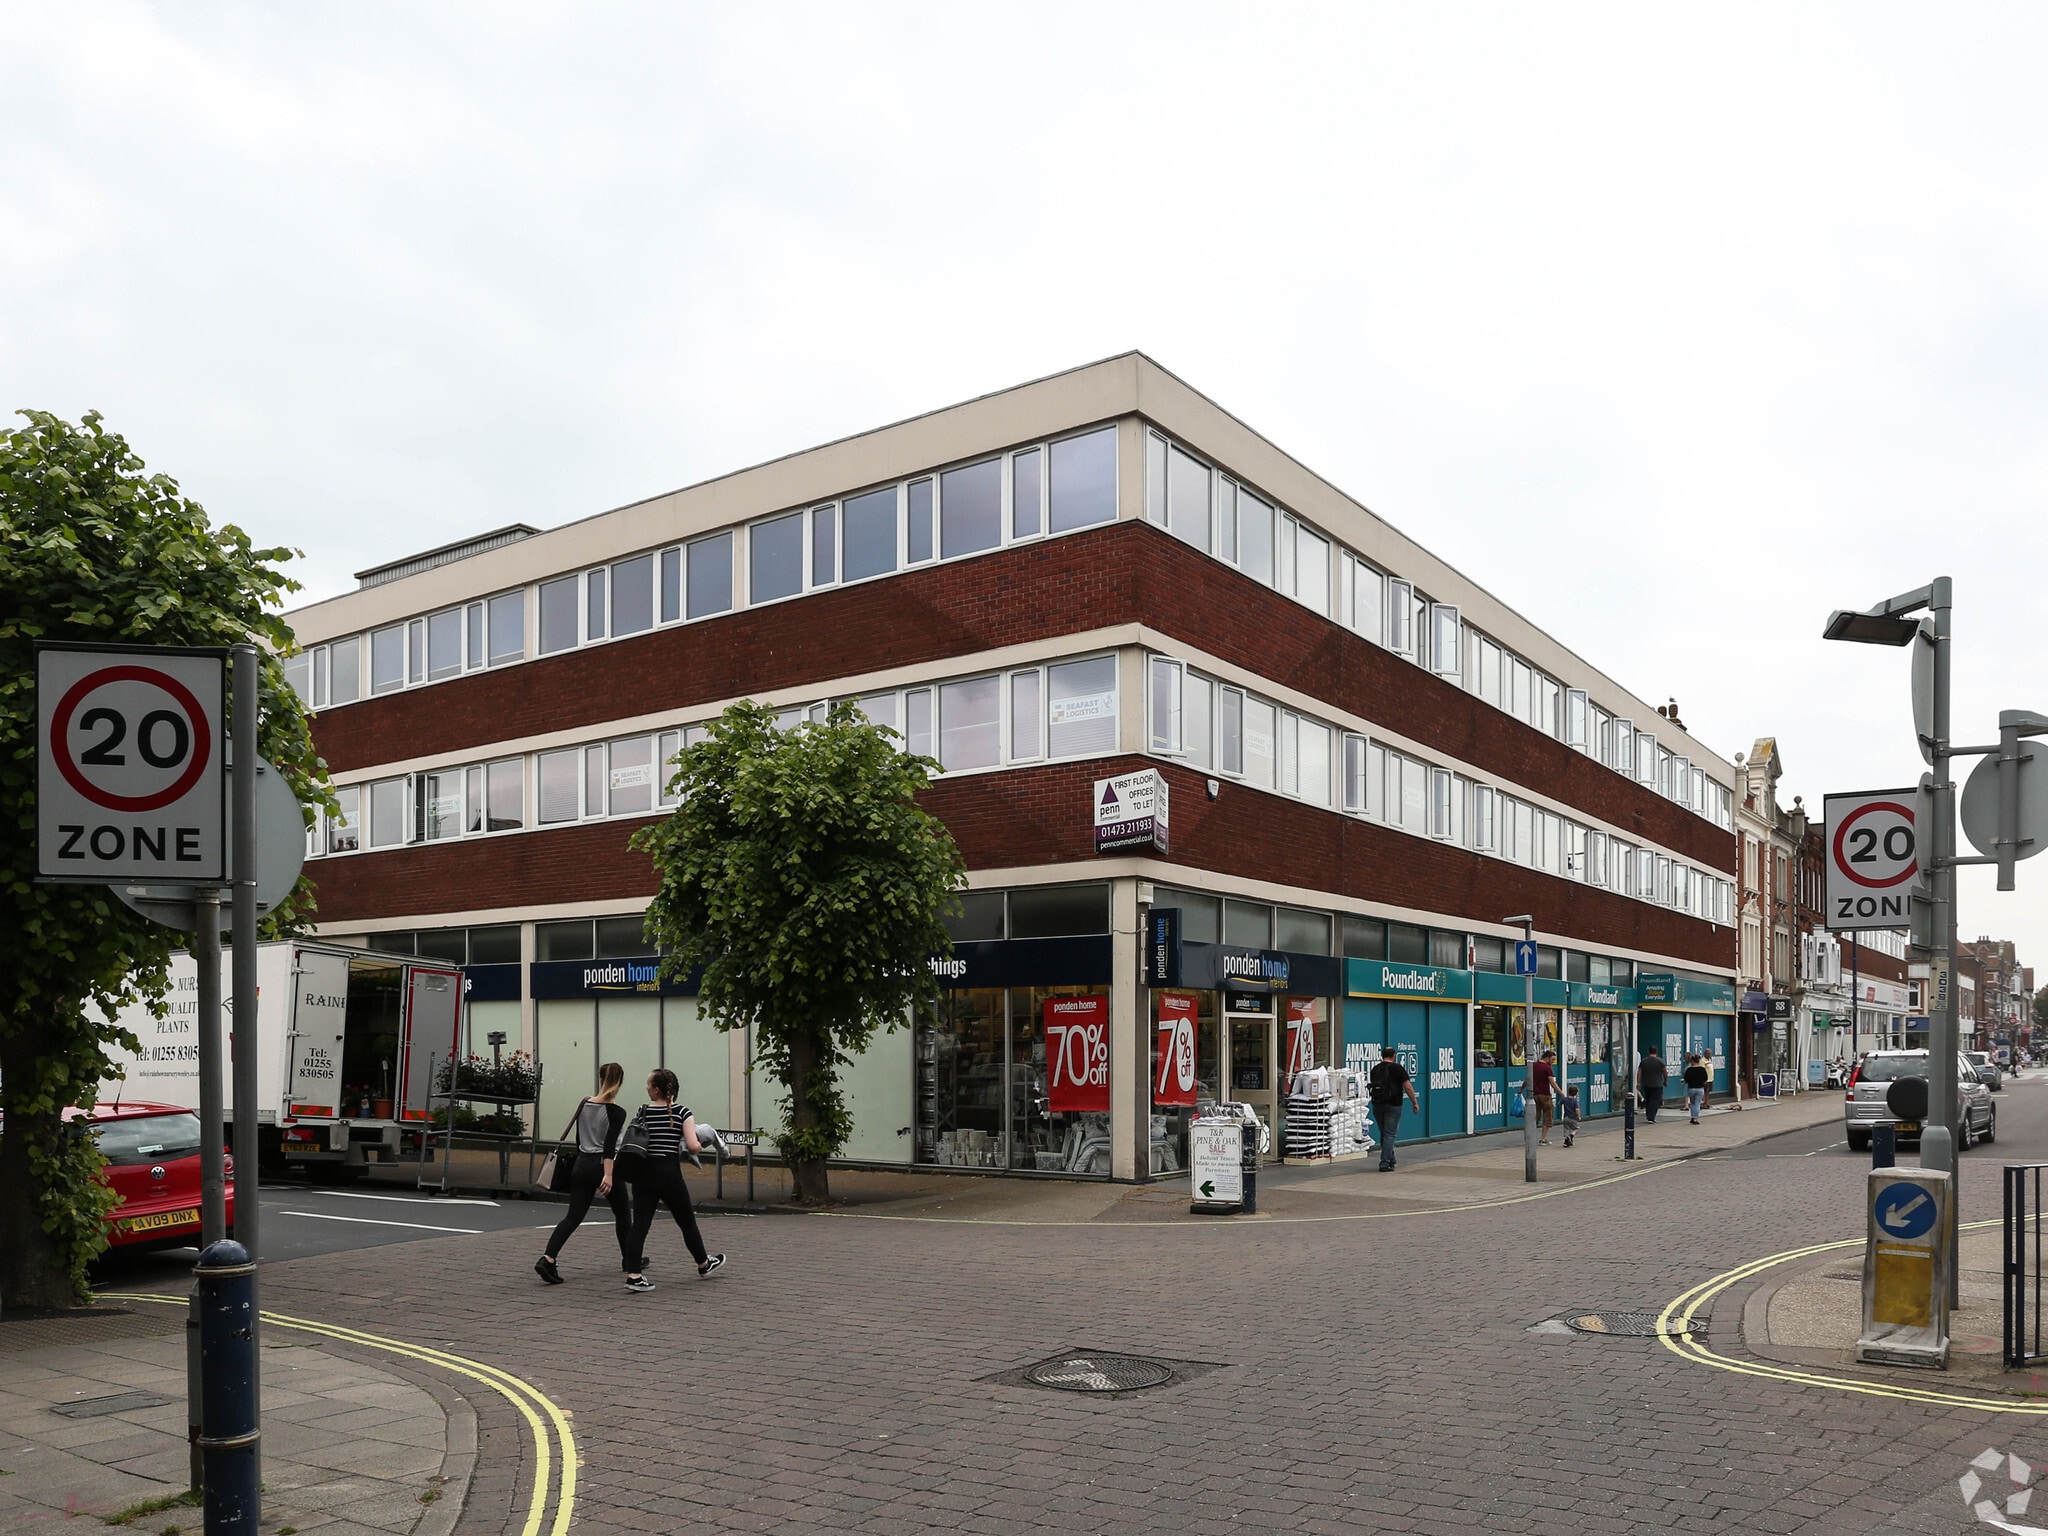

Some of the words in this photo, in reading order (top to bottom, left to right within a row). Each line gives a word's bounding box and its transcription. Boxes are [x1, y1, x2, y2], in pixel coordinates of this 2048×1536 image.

[1066, 700, 1098, 710] SEAFAST
[1066, 708, 1099, 718] LOGISTICS
[78, 707, 190, 769] 20
[1115, 779, 1131, 790] FIRST
[1132, 774, 1154, 786] FLOOR
[1128, 787, 1154, 799] OFFICES
[1100, 804, 1120, 818] penn
[1133, 802, 1142, 811] TO
[1143, 799, 1154, 809] LET
[1101, 824, 1125, 838] 01473
[1126, 818, 1152, 834] 211933
[57, 824, 202, 862] ZONE
[1100, 833, 1154, 850] penncommercial.co.uk
[1849, 825, 1915, 863] 20
[1837, 895, 1911, 918] ZON
[1156, 918, 1165, 944] home
[1155, 945, 1167, 979] ponden
[1223, 952, 1260, 979] ponden
[1262, 954, 1288, 978] home
[584, 963, 625, 988] ponden
[1382, 966, 1435, 991] Poundland
[177, 977, 198, 991] NUR
[1588, 987, 1618, 1004] Poundland
[166, 1001, 198, 1017] QUALIT
[1053, 1001, 1078, 1013] ponden
[1078, 1000, 1097, 1010] home
[156, 1020, 190, 1034] PLANTS
[152, 1045, 176, 1061] 01255
[177, 1045, 199, 1061] 8305
[308, 1047, 328, 1058] Tel:
[1047, 1023, 1108, 1087] 70%
[1345, 1043, 1382, 1061] AMAZING
[1438, 1047, 1454, 1071] BIG
[304, 1057, 332, 1069] 01255
[1180, 1062, 1191, 1078] off
[299, 1067, 335, 1080] 830505
[1089, 1062, 1108, 1085] off
[1430, 1071, 1462, 1090] BRANDS!
[1481, 1081, 1492, 1094] POP
[1590, 1083, 1609, 1103] TODAY!
[1475, 1093, 1502, 1116] TODAY!
[733, 1133, 754, 1144] ROAD
[1196, 1136, 1214, 1145] PINE
[1214, 1137, 1221, 1145] &
[1222, 1137, 1238, 1145] OAK
[1209, 1128, 1224, 1137] T&R
[1208, 1144, 1226, 1153] SALE
[138, 1214, 169, 1229] AV09
[171, 1210, 194, 1223] DNX
